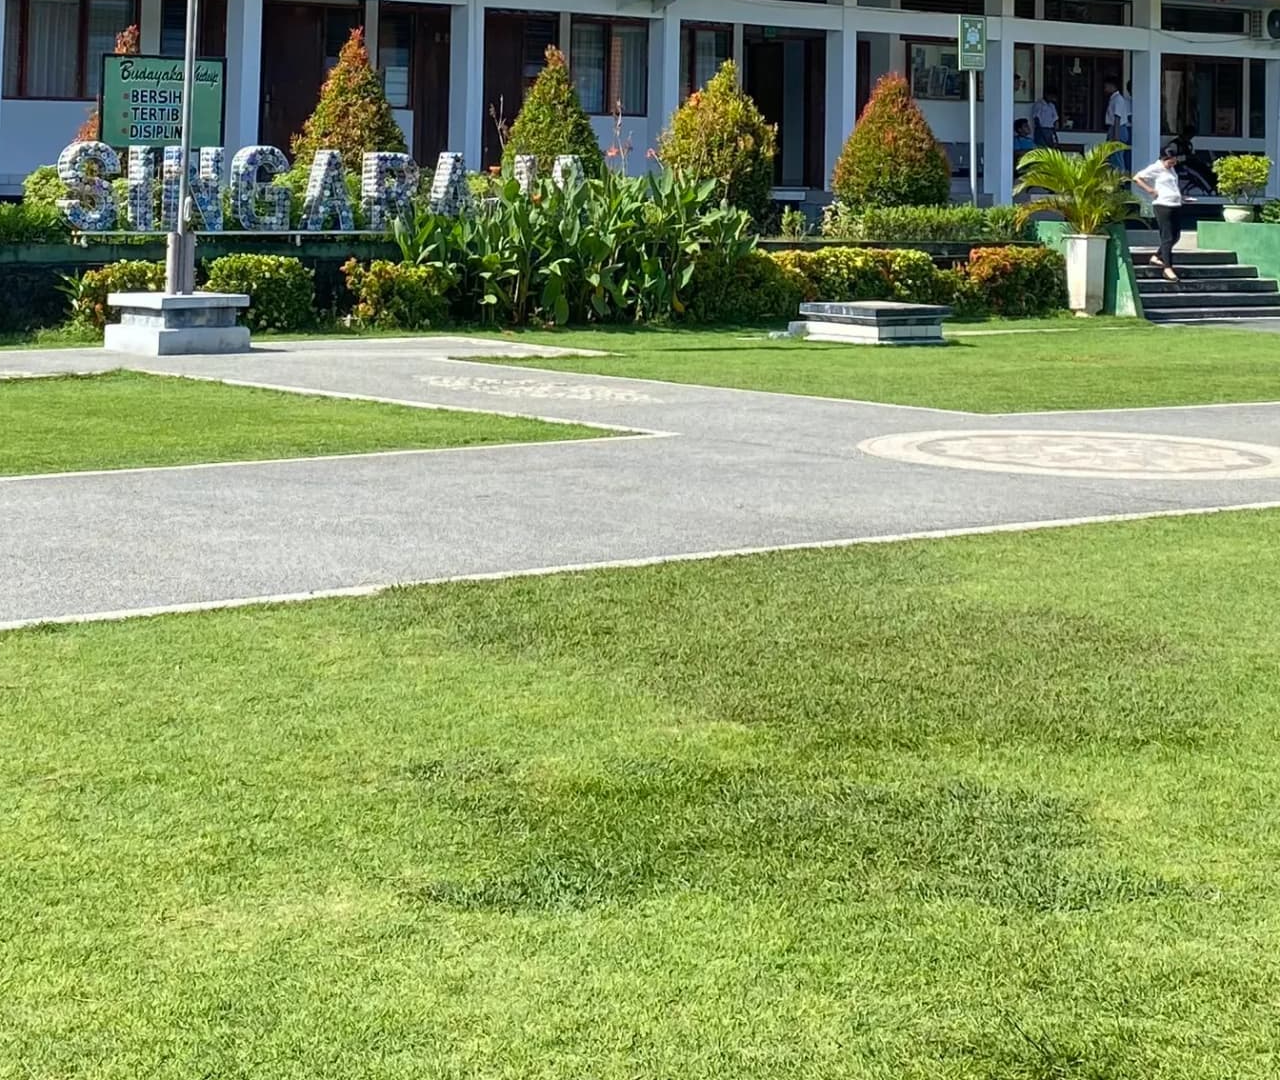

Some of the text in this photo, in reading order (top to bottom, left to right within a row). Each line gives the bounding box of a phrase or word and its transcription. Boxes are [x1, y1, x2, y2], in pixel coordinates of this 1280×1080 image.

[120, 60, 186, 87] Budayaka
[131, 90, 182, 104] BERSIH
[131, 108, 179, 121] TERTIB
[130, 125, 183, 138] DISIPLIN
